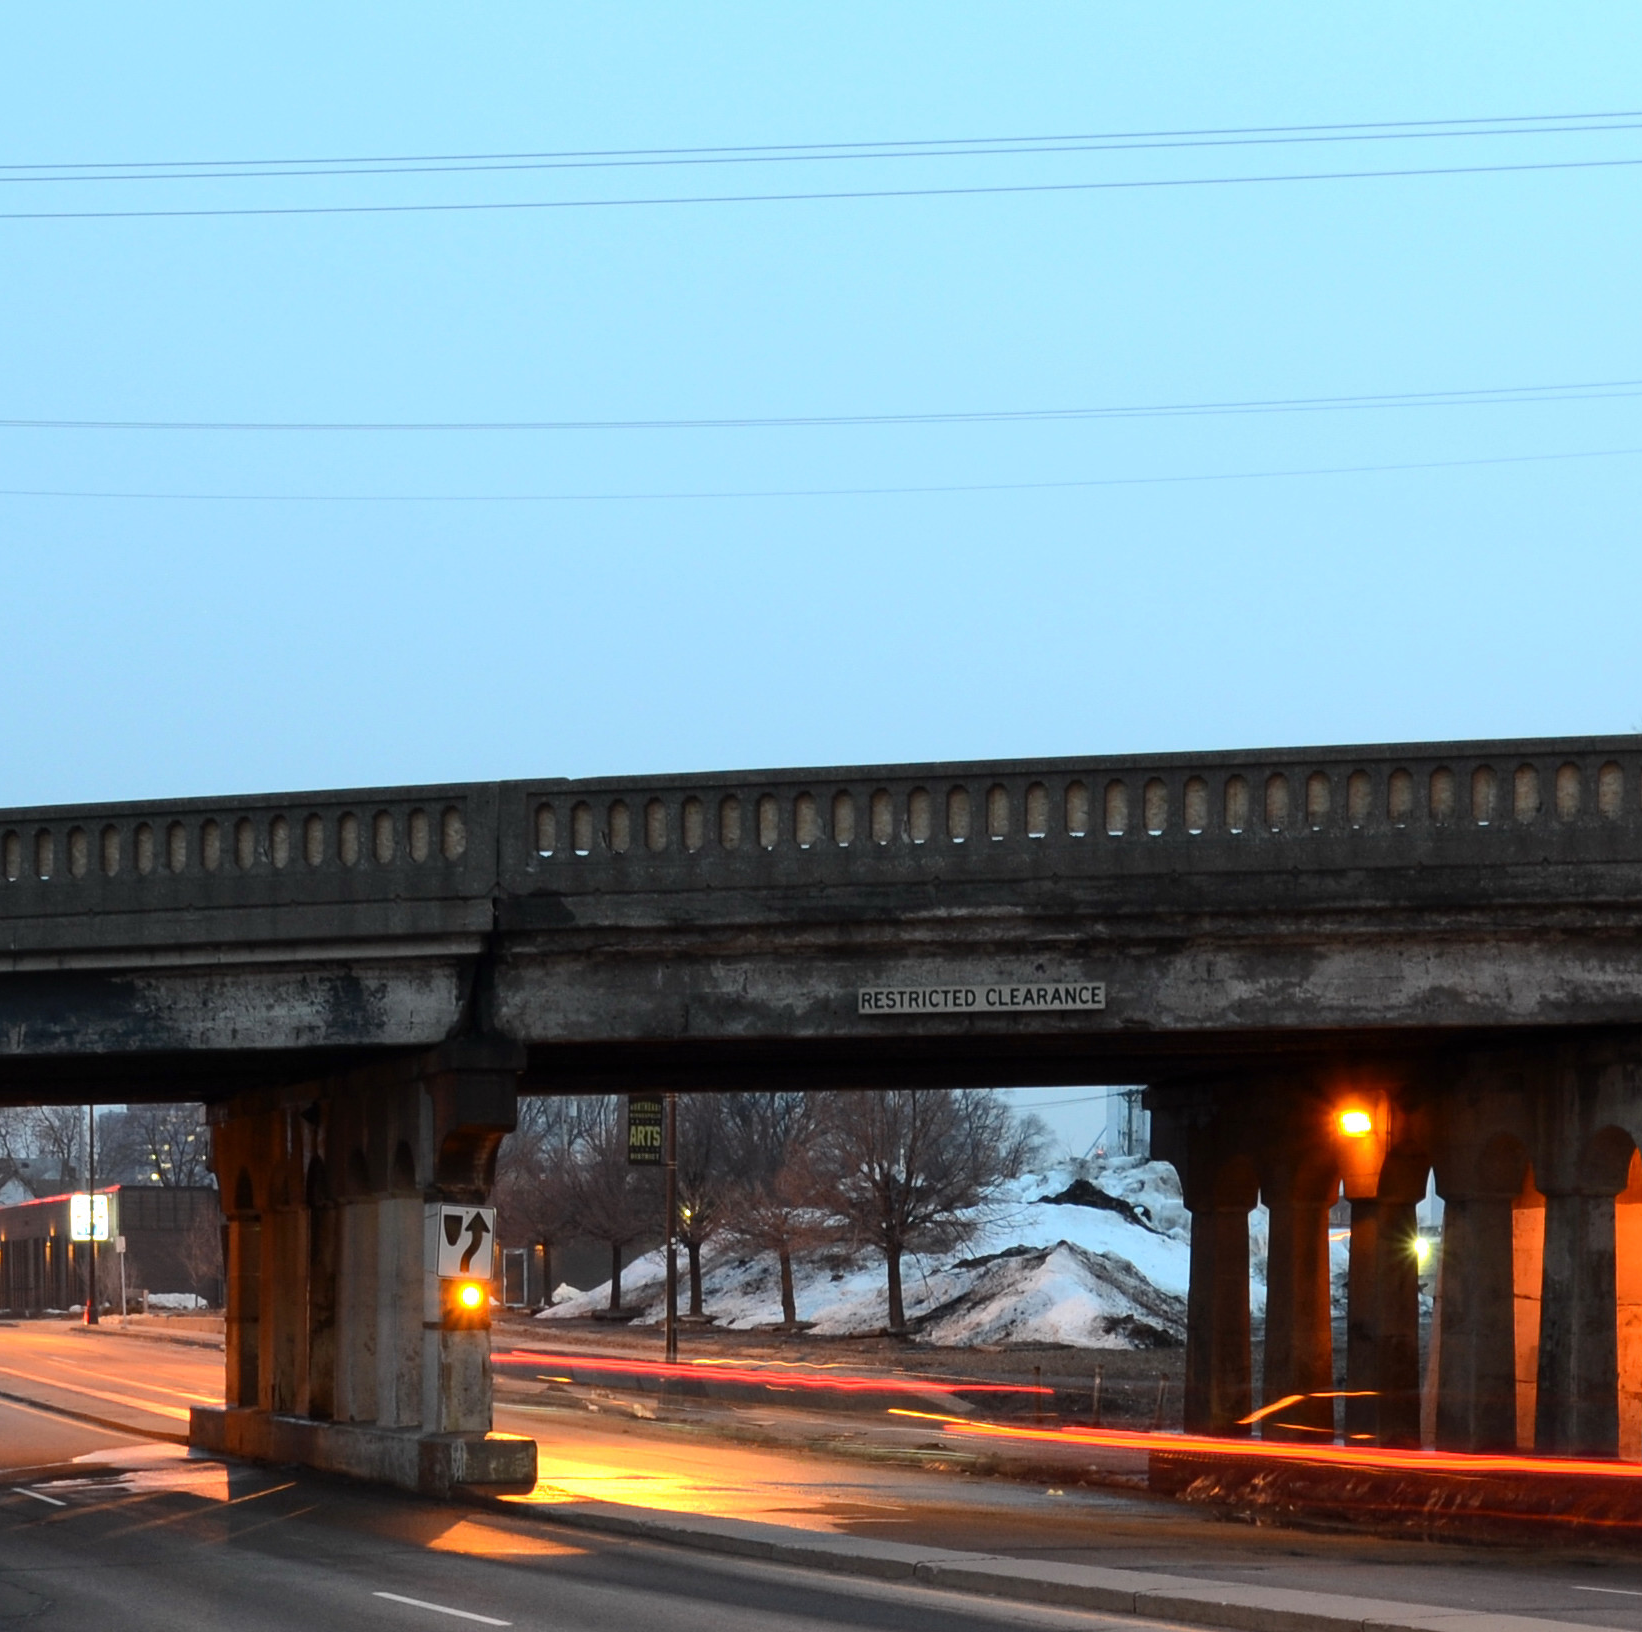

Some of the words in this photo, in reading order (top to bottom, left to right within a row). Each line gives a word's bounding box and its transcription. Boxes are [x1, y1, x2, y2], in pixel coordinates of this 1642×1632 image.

[861, 989, 976, 1009] RESTRICTED
[985, 986, 1103, 1007] CLEARANCE
[629, 1126, 661, 1146] ARTS
